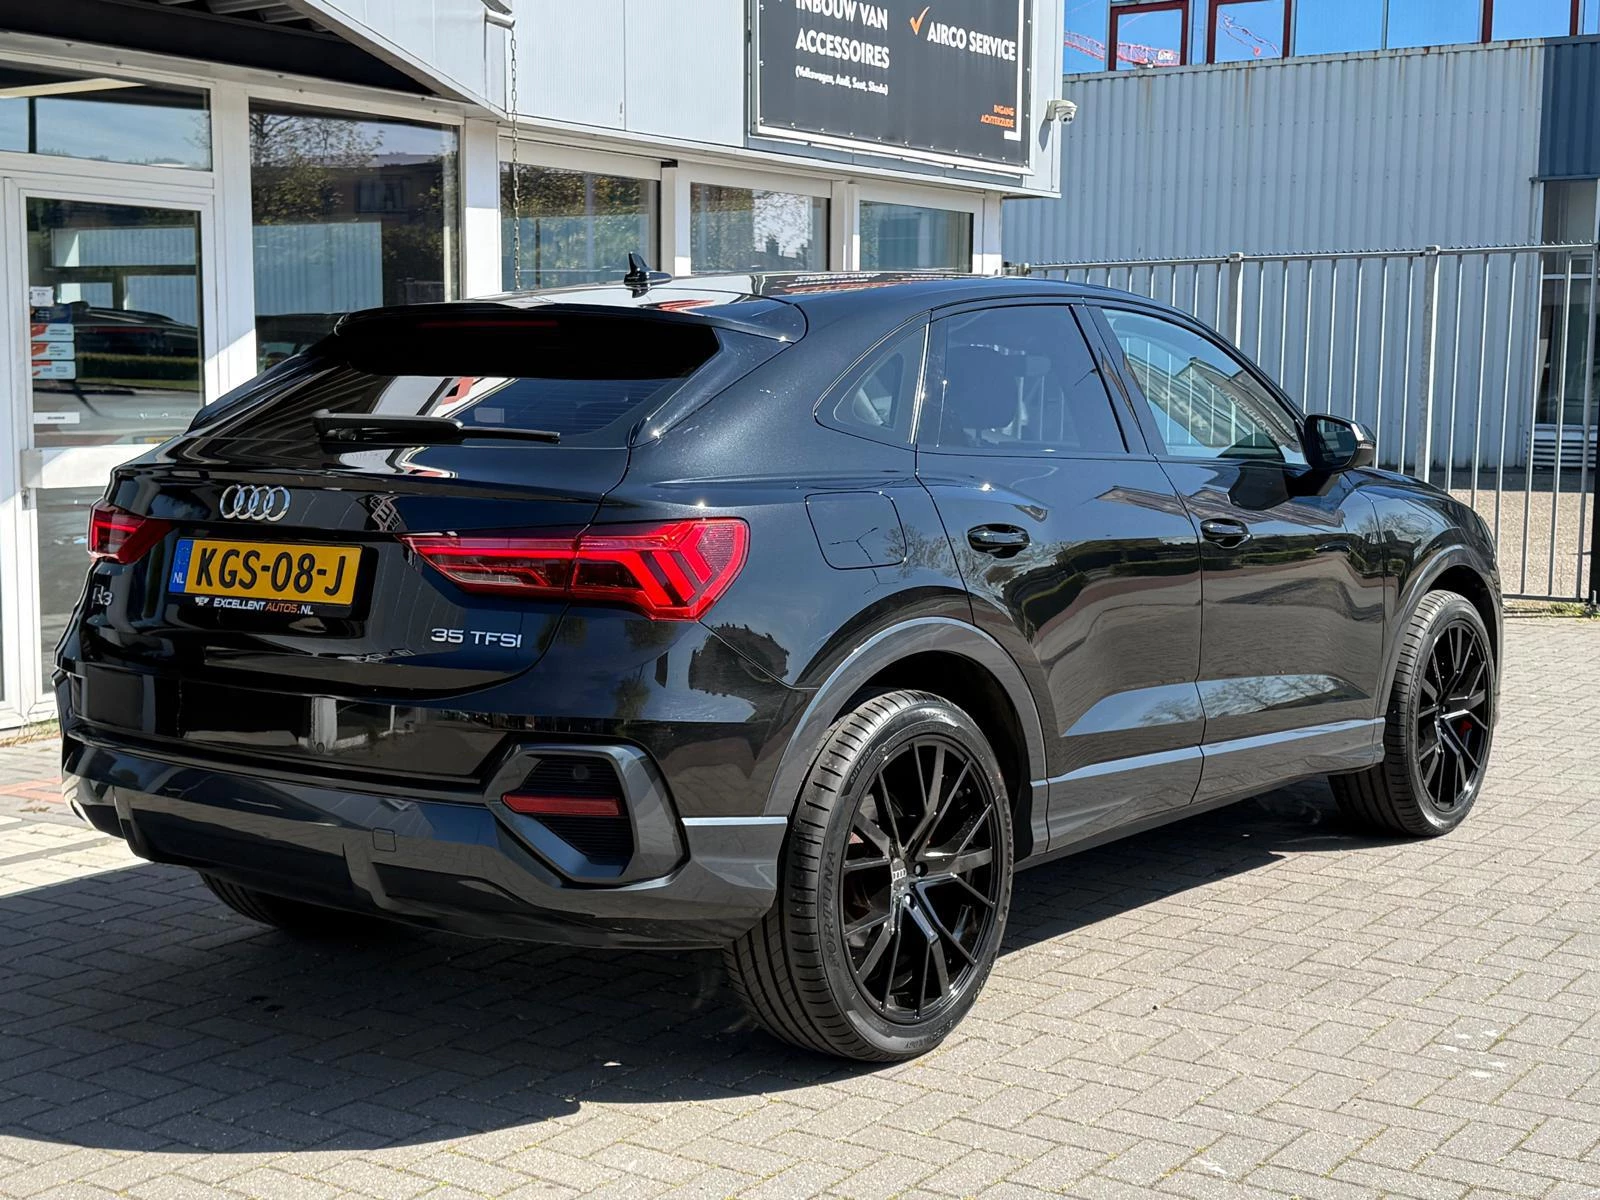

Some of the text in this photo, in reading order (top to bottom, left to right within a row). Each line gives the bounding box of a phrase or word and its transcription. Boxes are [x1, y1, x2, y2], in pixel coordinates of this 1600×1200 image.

[859, 3, 888, 31] VAN
[795, 27, 890, 69] ACCESSOIRES
[927, 21, 1016, 61] AIRCO SERVICE
[172, 571, 185, 584] NL
[195, 547, 347, 597] KGS-08-J
[430, 628, 522, 648] 35 TFSI
